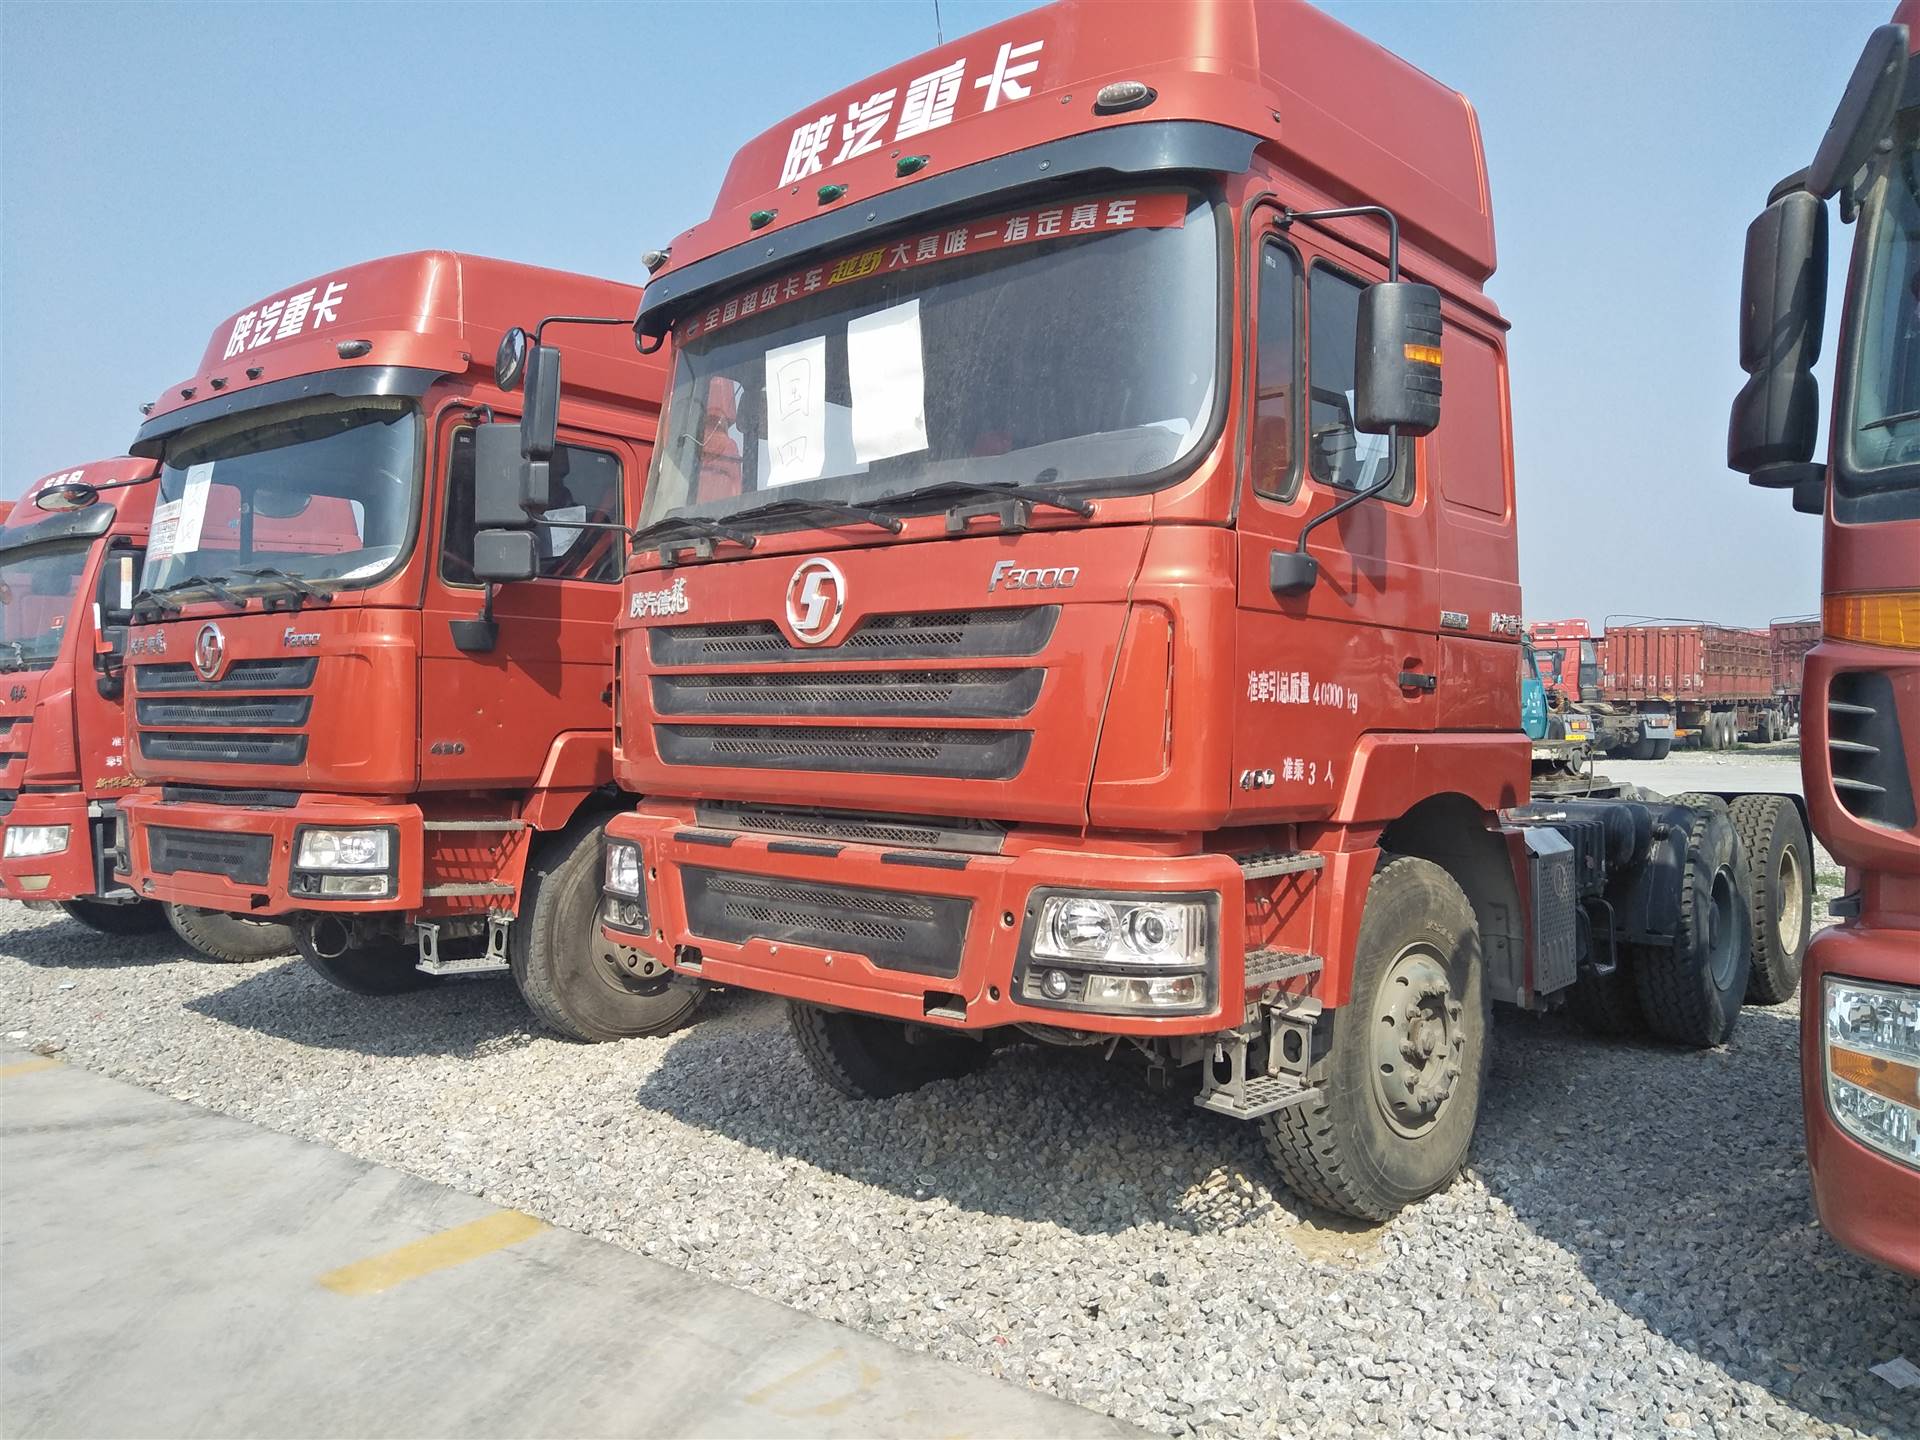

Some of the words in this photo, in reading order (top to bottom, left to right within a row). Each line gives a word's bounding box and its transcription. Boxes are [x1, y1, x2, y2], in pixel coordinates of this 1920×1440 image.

[777, 40, 1044, 189] 陕汽重卡
[223, 281, 348, 361] 陕汽重卡
[988, 559, 1080, 592] F3000
[1247, 670, 1310, 704] 准牵引总质量
[1347, 687, 1358, 714] kg
[1283, 757, 1304, 782] 准乘
[1308, 762, 1316, 785] 3
[1324, 760, 1334, 790] 人
